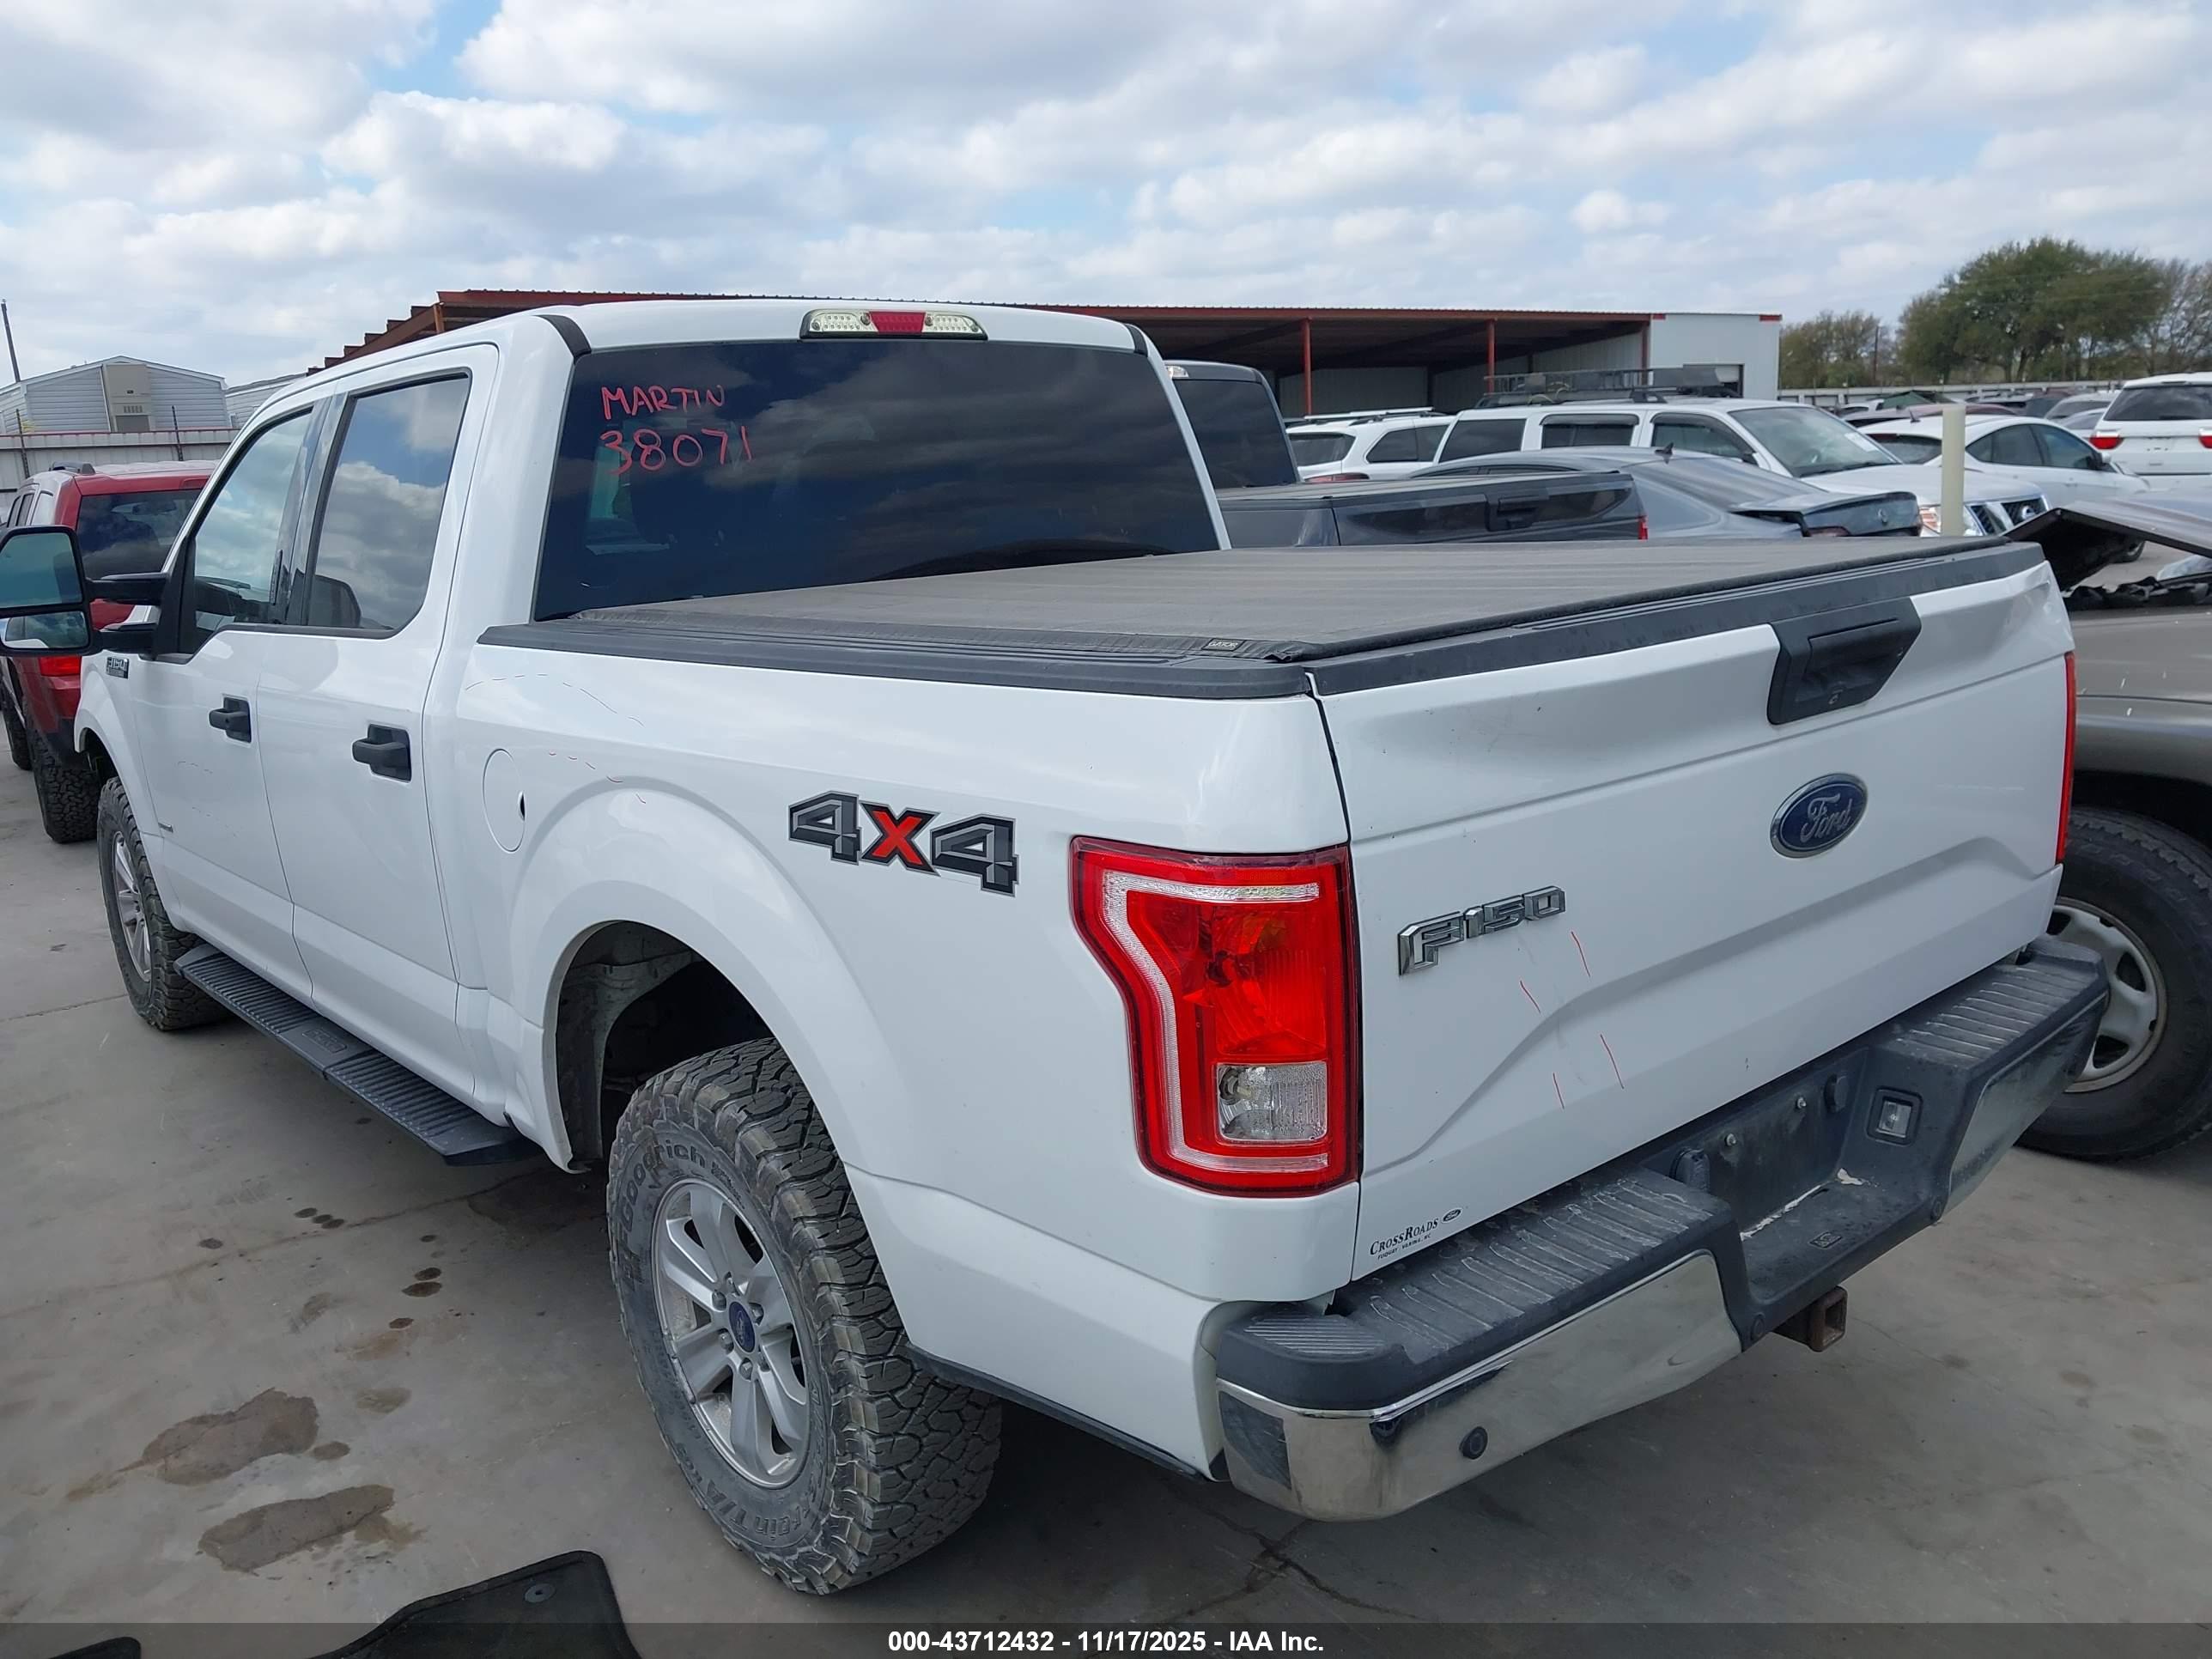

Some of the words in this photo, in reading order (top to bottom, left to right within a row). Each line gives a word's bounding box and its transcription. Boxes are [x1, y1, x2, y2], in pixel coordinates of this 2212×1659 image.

[602, 385, 725, 420] MARTIN
[600, 426, 752, 475] 38071
[1800, 793, 1852, 842] Ford
[1397, 885, 1565, 975] F150
